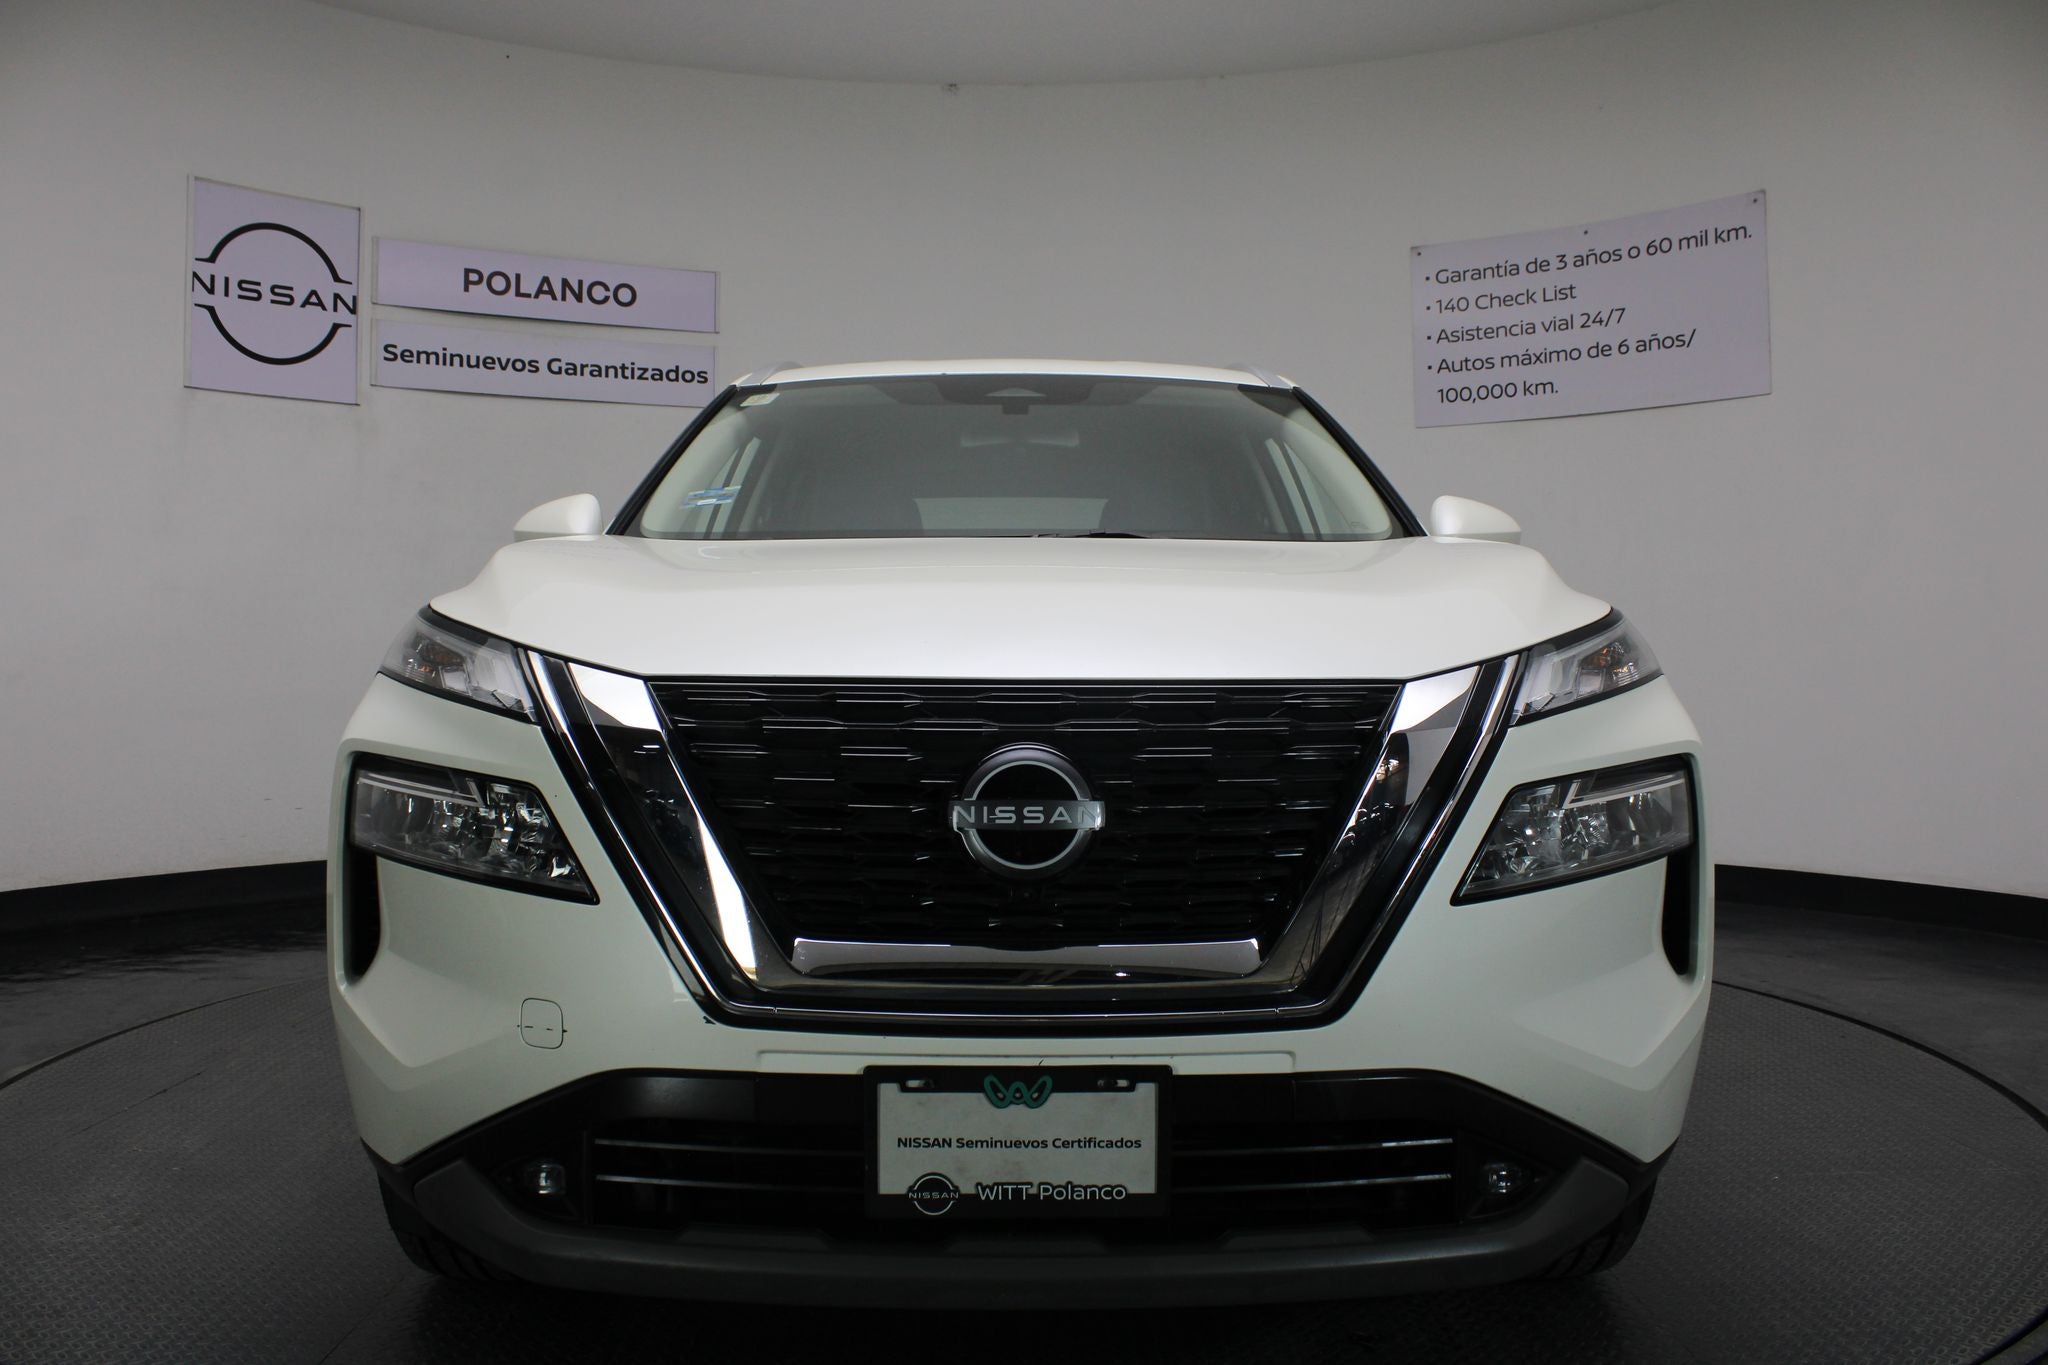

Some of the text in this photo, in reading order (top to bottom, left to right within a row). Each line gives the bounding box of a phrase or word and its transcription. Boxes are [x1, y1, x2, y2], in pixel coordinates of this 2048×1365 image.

[1436, 224, 1752, 285] Garantía de 3 años o 60 mil km.
[192, 270, 356, 315] NISSAN
[463, 267, 637, 307] POLANCO
[1436, 283, 1577, 314] 140 Check List
[1436, 307, 1626, 344] Asistencia vial 24/7
[382, 343, 709, 385] Seminuevos Garantizados
[1437, 329, 1697, 374] Autos máximo de 6 años/
[1437, 380, 1559, 404] 100,000 km.
[953, 804, 1100, 826] NISSAN
[897, 1137, 1142, 1149] NISSAN Seminuevos Certificados
[908, 1191, 960, 1200] NISSAN
[977, 1182, 1127, 1201] WITT Polanco
